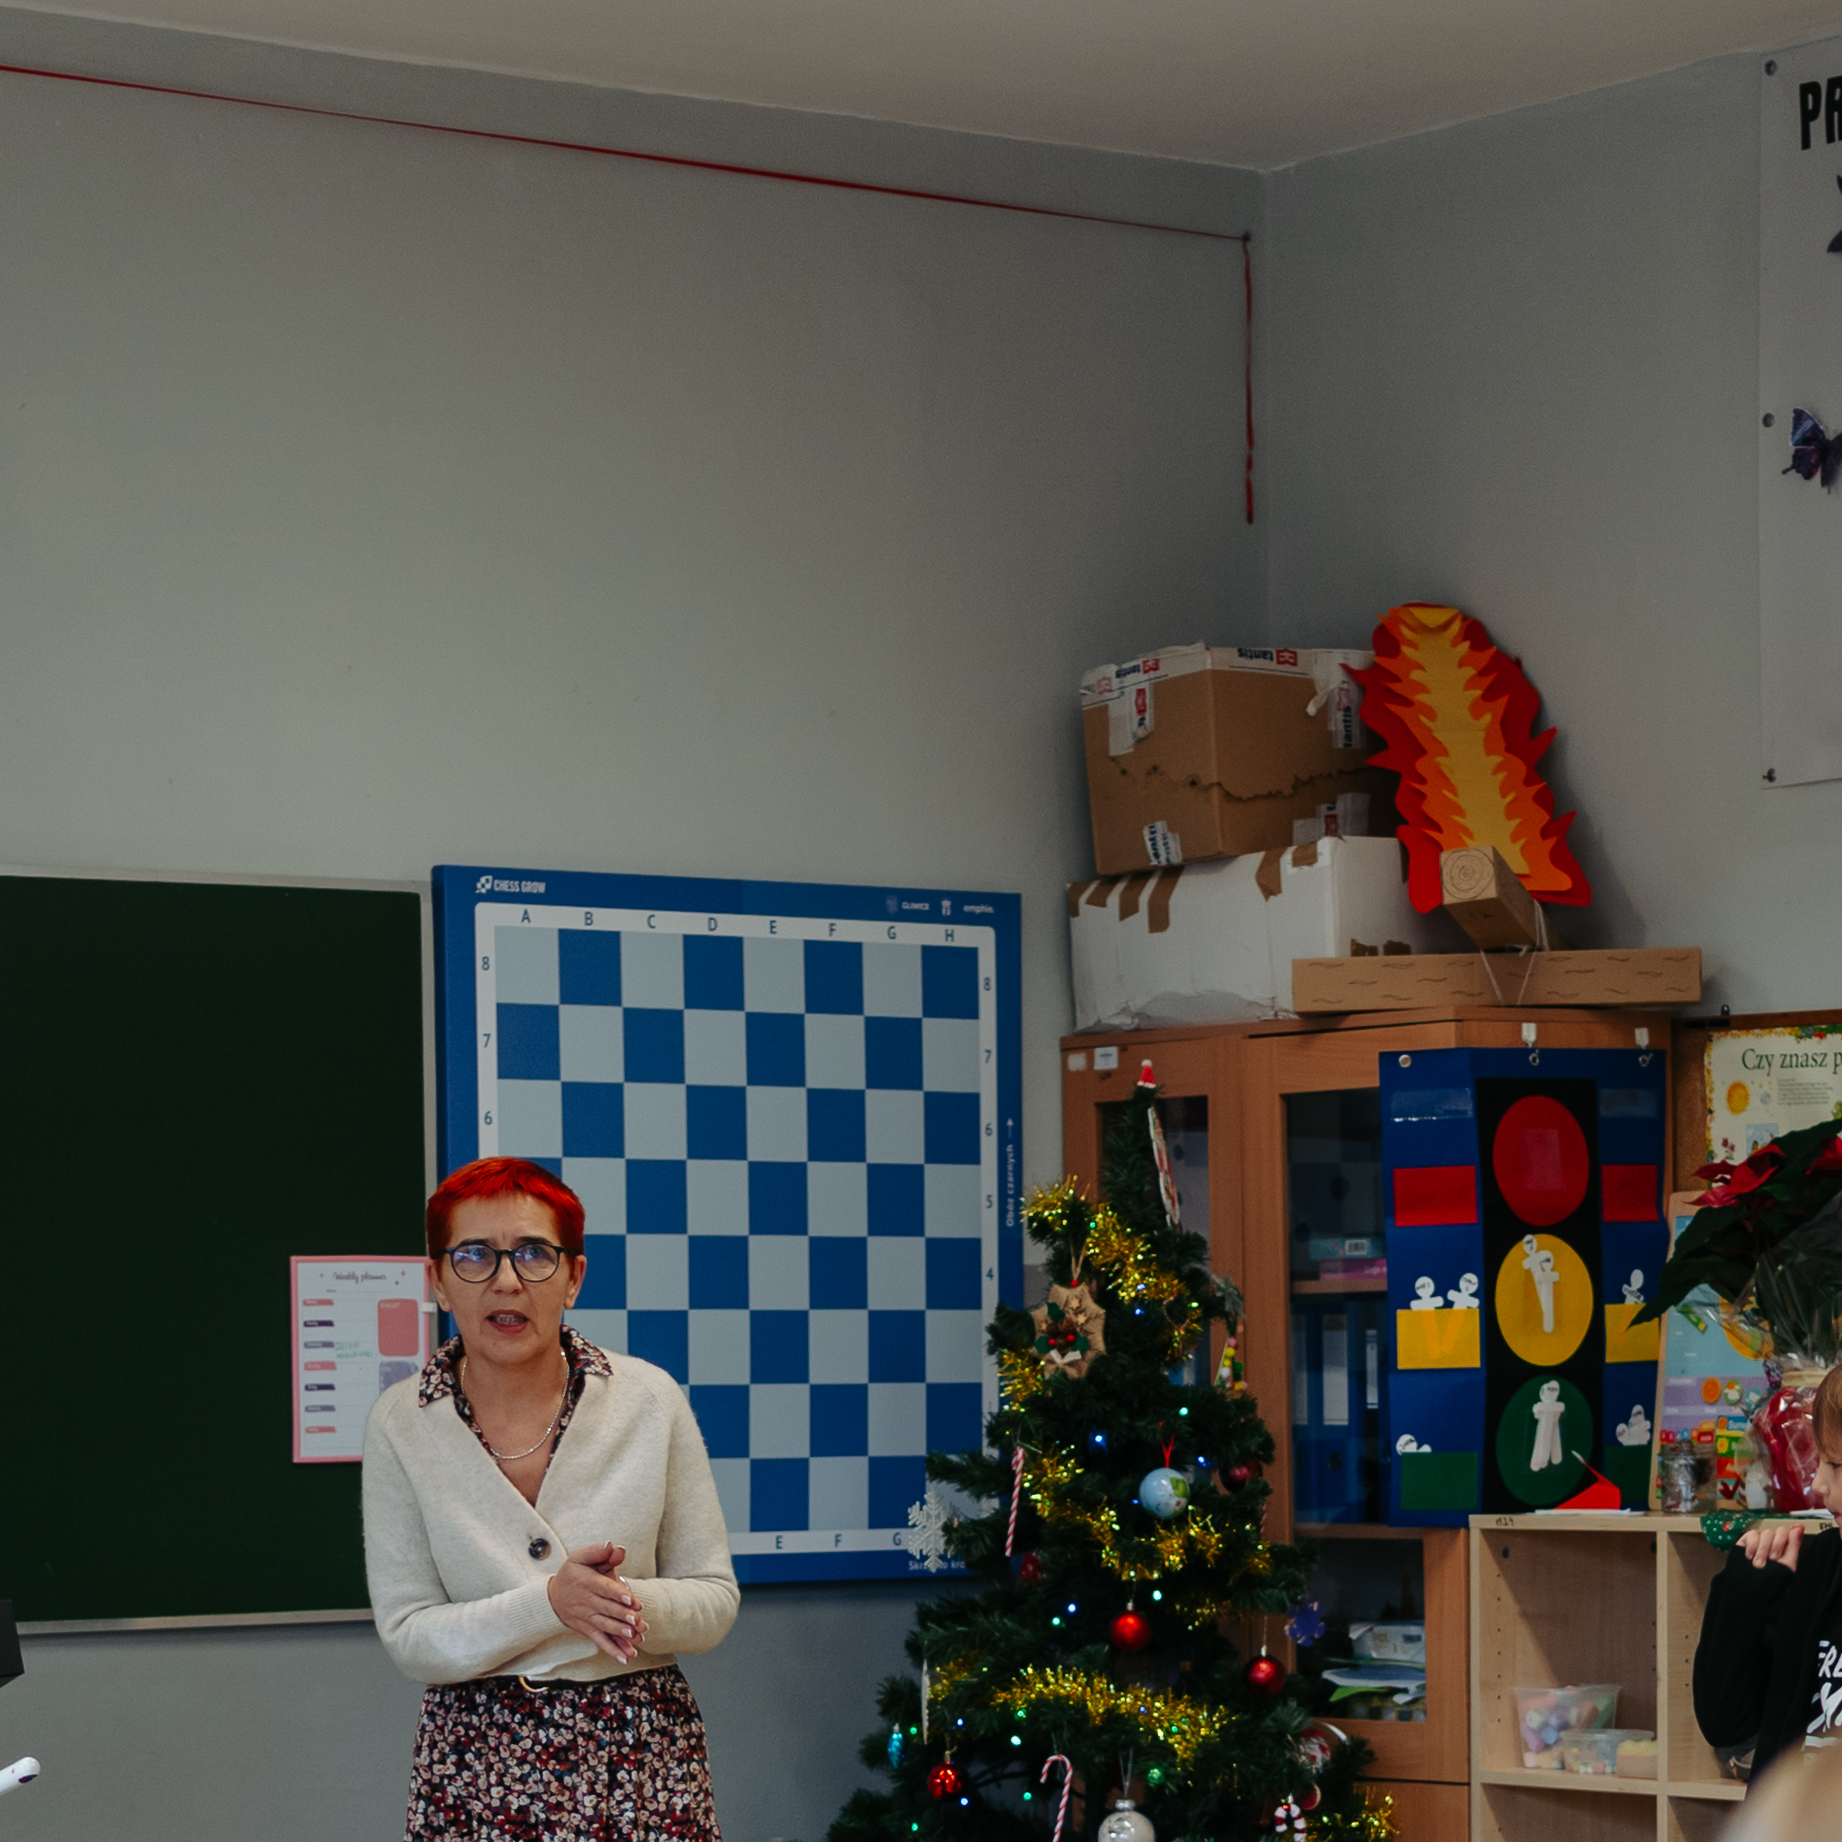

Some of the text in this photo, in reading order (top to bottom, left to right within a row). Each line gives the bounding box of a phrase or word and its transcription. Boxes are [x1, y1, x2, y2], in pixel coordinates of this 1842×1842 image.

[1237, 647, 1274, 662] tantis
[494, 879, 546, 894] CHESS GROW
[522, 909, 956, 943] A B C D E F G H
[482, 956, 490, 971] 8
[984, 978, 992, 992] 8
[483, 1034, 491, 1048] 7
[985, 1050, 993, 1064] 7
[1741, 1048, 1775, 1076] Czy
[1780, 1052, 1828, 1069] znasz
[484, 1111, 493, 1126] 6
[985, 1124, 993, 1137] 6
[986, 1267, 994, 1281] 4
[775, 1531, 902, 1549] E F G
